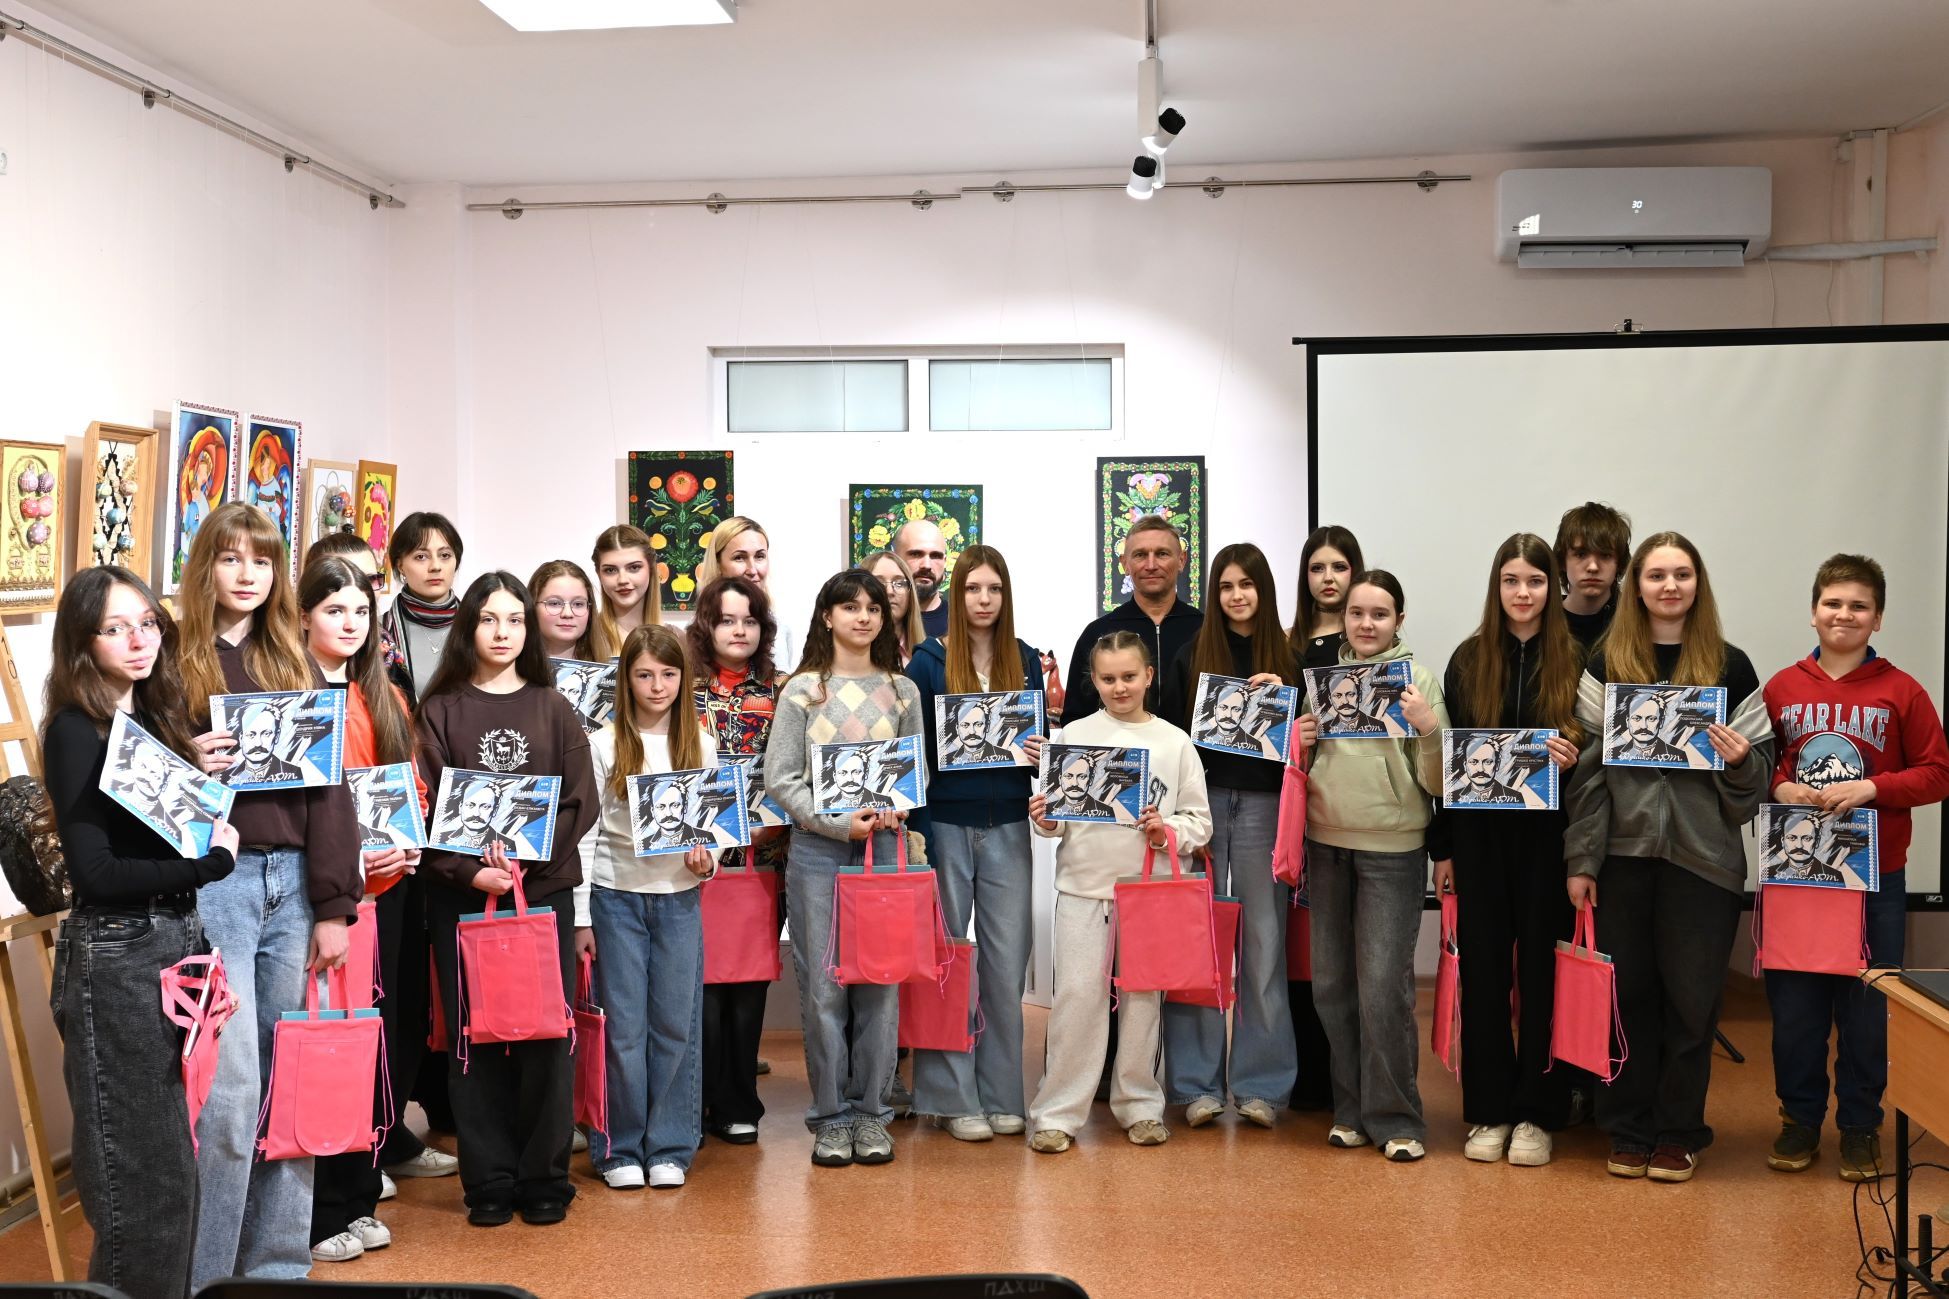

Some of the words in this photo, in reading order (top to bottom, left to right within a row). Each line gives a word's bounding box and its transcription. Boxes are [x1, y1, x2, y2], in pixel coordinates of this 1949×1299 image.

[1631, 200, 1643, 209] 30
[601, 677, 616, 685] ДИП
[1372, 674, 1404, 683] ДИПЛОМ
[1260, 695, 1289, 706] ДИПЛОМ
[1679, 701, 1716, 709] ДИПЛОМ
[296, 706, 333, 717] ДИПЛОМ
[1001, 703, 1033, 712] ДИПЛОМ
[1833, 703, 1890, 752] LAKE
[1513, 743, 1547, 751] ДИПЛОМ
[881, 749, 914, 760] ДИПЛОМ
[1107, 760, 1140, 768] ДИПЛОМ
[749, 767, 765, 775] ДИП
[700, 779, 734, 791] ДИПЛОМ
[515, 789, 550, 799] ДИПЛОМ
[1834, 821, 1868, 830] ДИПЛОМ
